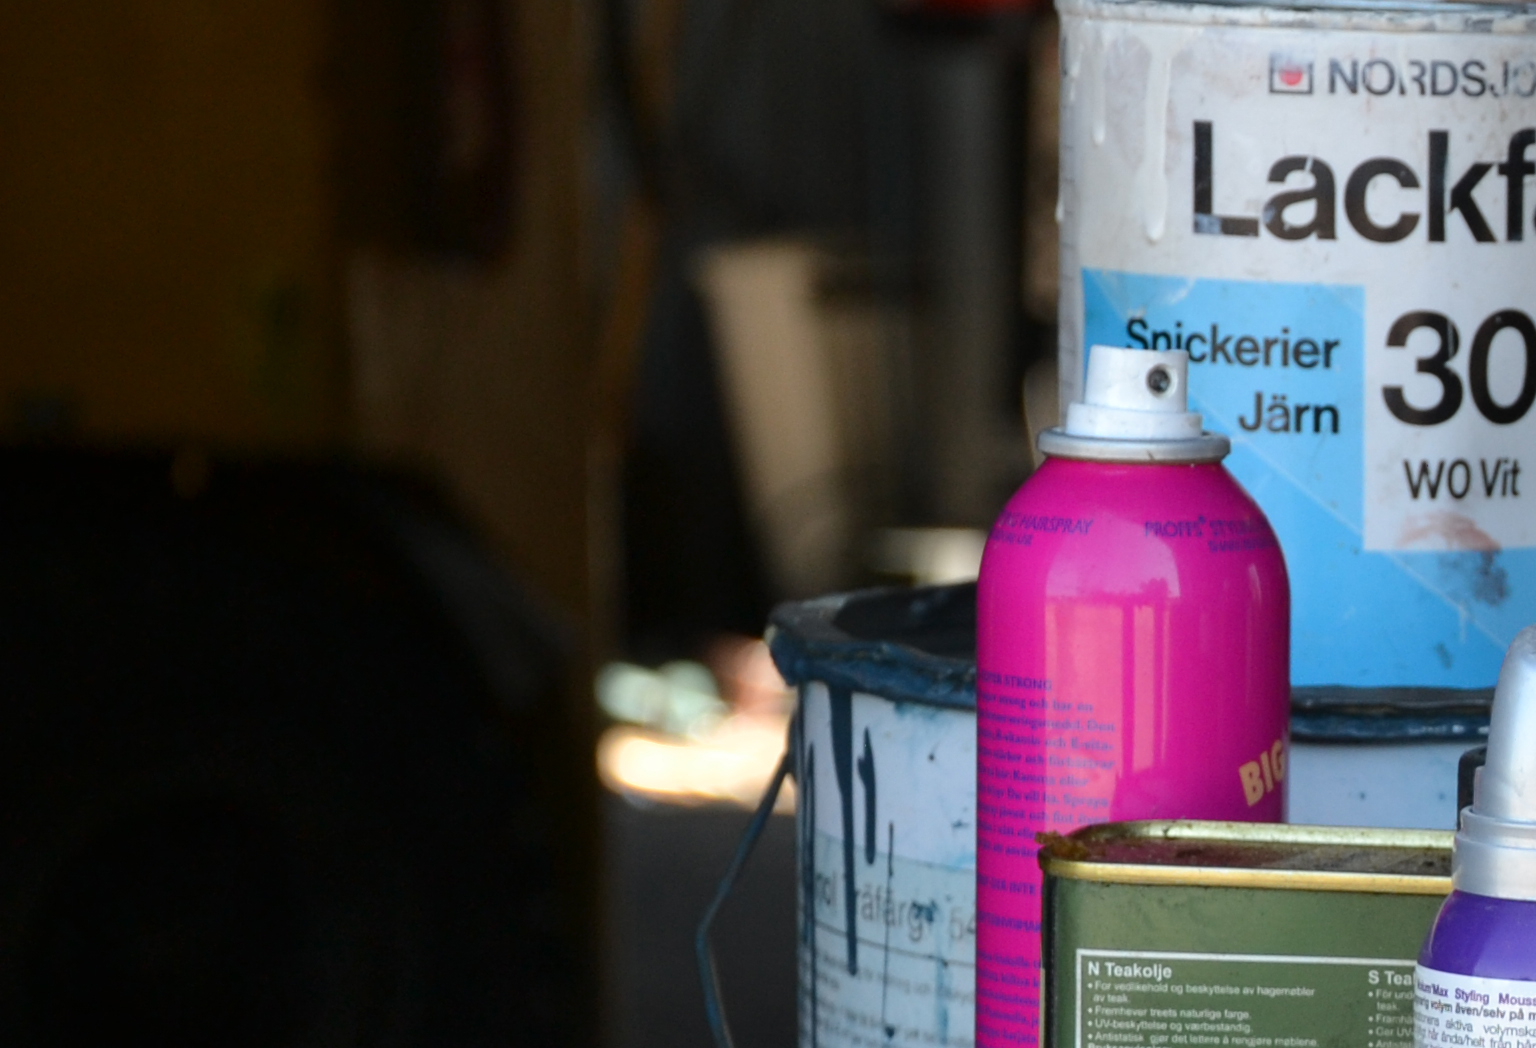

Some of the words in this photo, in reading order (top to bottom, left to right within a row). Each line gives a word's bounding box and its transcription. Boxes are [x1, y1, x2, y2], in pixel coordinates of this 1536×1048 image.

[1238, 392, 1340, 434] Järn
[1482, 458, 1522, 497] Vit
[1238, 739, 1285, 807] BIG
[1105, 963, 1172, 979] Teakolje
[1455, 988, 1490, 1006] Styling
